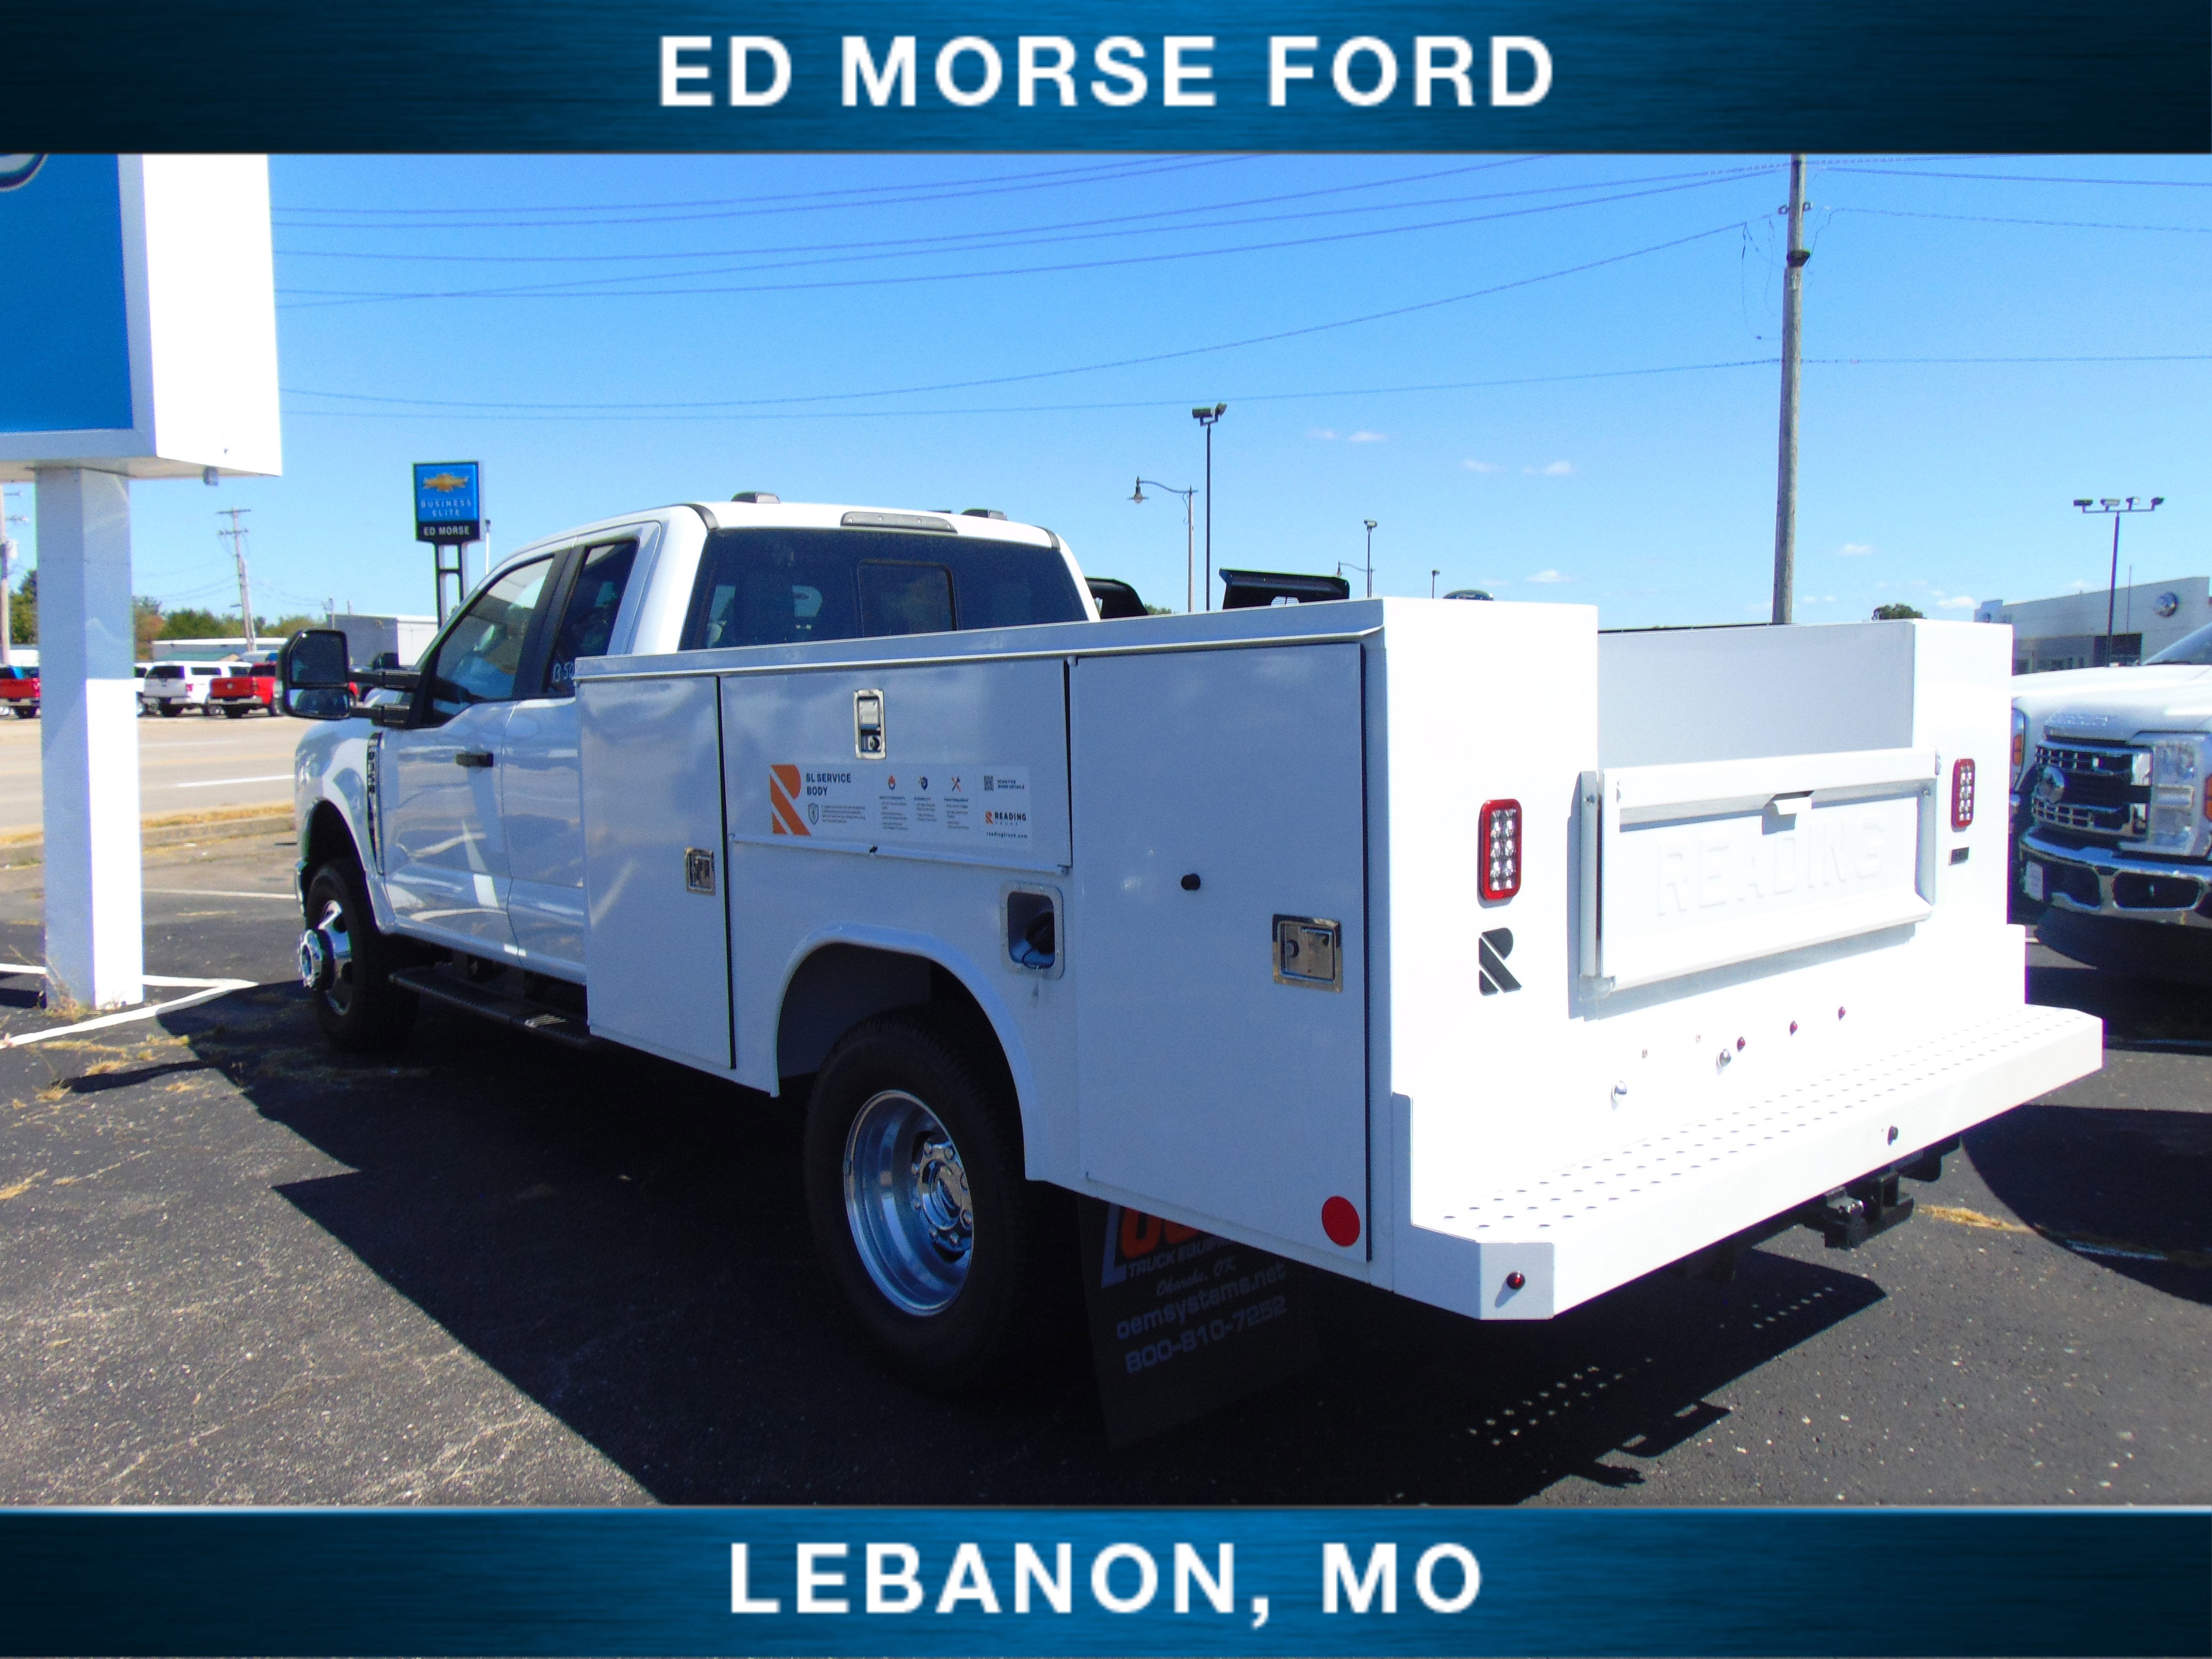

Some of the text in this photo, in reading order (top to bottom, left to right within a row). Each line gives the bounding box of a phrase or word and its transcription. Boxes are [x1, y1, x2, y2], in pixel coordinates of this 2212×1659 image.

[421, 498, 471, 508] BUSINESS
[432, 509, 460, 517] ELITE
[423, 525, 470, 536] ED MORSE
[817, 773, 852, 783] SERVICE
[807, 786, 828, 796] BODY
[994, 811, 1027, 821] READING
[1656, 811, 1885, 917] READING
[1128, 1247, 1176, 1279] TRUCK
[1116, 1261, 1287, 1340] oemsystems.net
[1124, 1294, 1288, 1373] 800-810-7252
